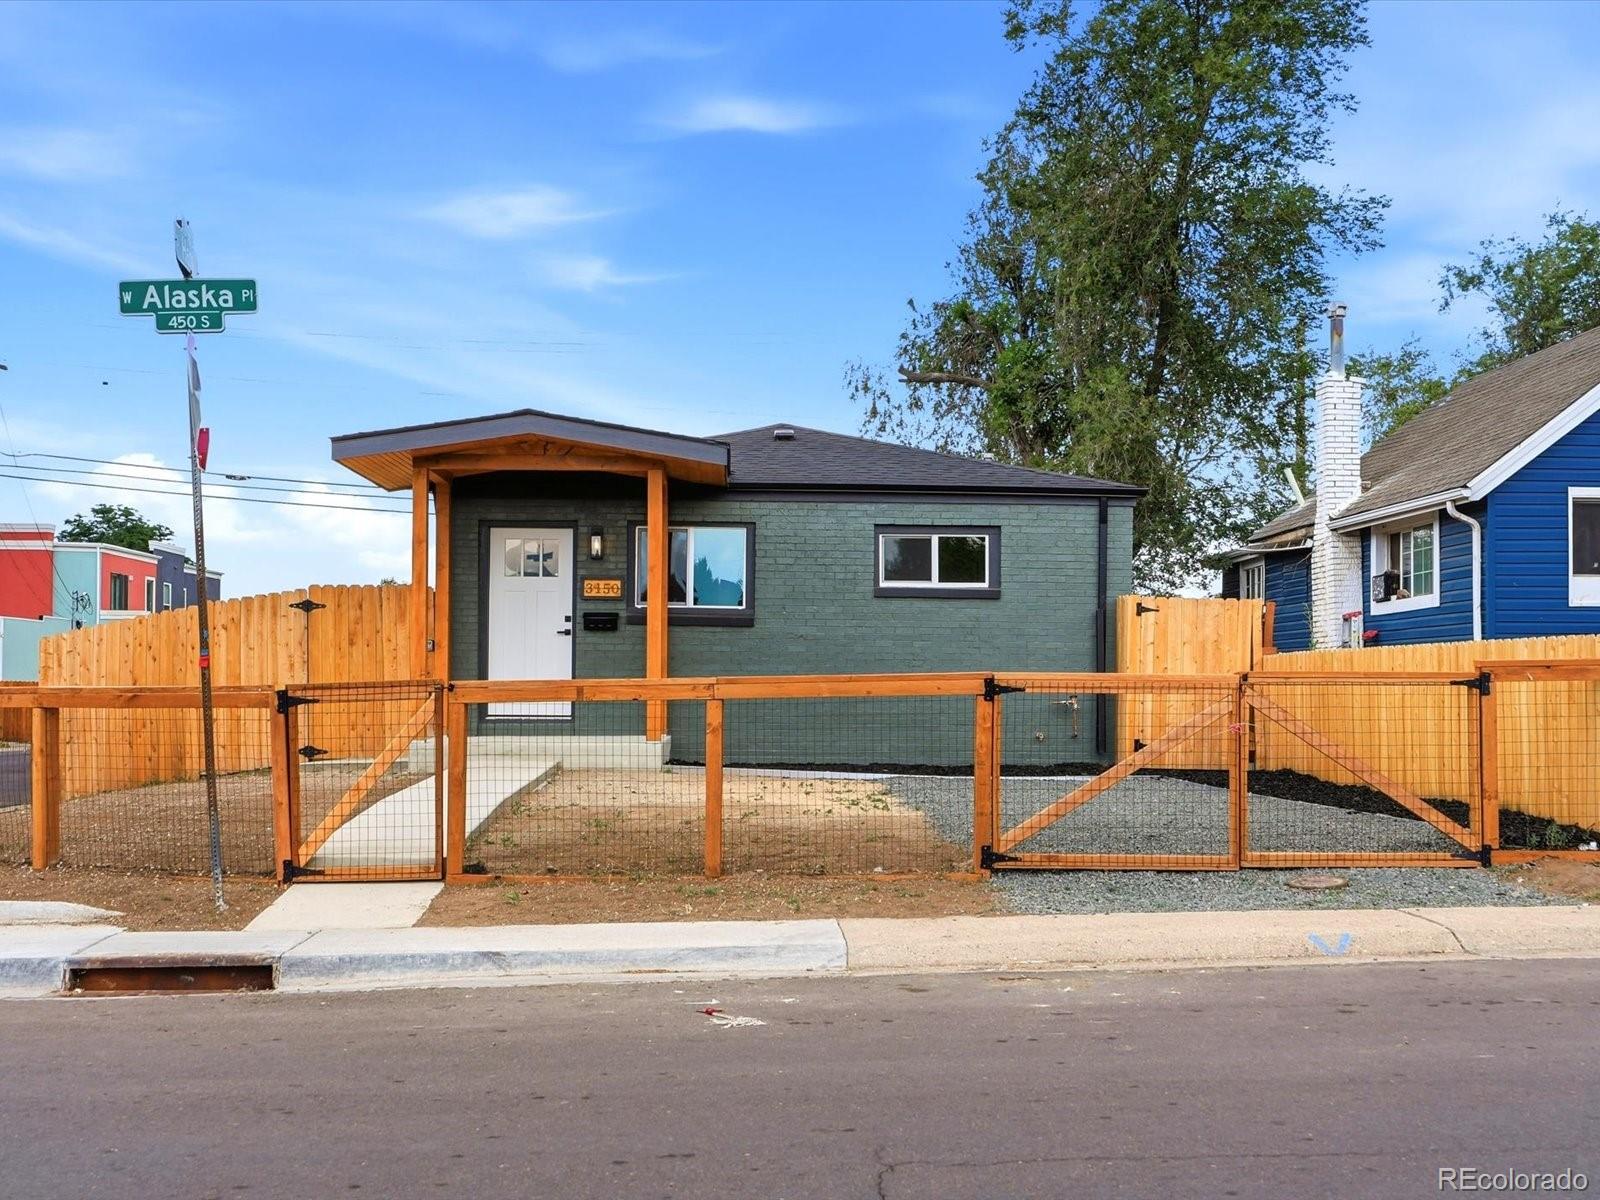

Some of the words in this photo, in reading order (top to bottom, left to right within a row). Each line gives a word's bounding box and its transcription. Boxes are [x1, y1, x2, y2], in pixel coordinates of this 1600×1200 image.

[122, 291, 132, 304] W
[142, 284, 234, 309] Alaska
[241, 289, 254, 302] Pl
[168, 315, 197, 329] 450
[201, 315, 210, 328] S
